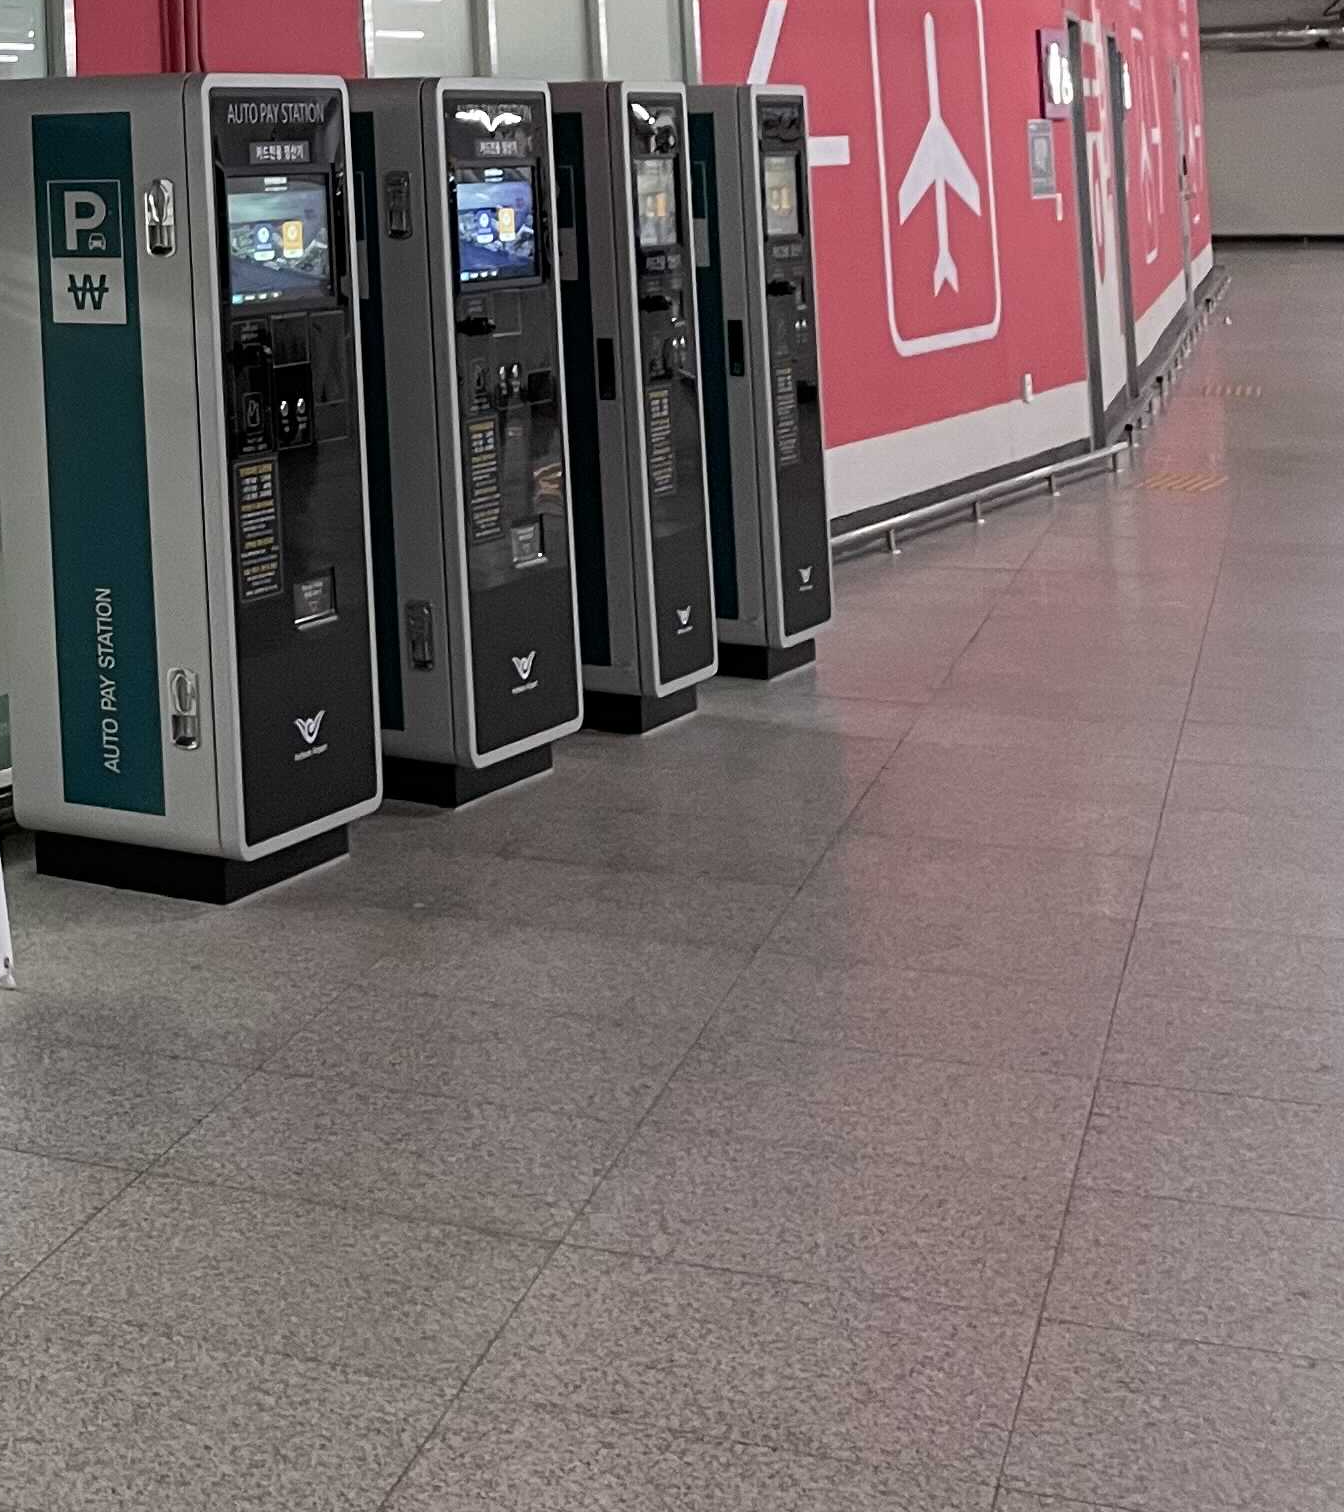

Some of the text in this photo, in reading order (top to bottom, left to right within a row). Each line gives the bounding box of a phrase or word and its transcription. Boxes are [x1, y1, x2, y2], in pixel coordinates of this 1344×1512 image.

[227, 102, 325, 125] AUTO PAY STATION
[95, 588, 121, 774] AUTO PAY STATION
